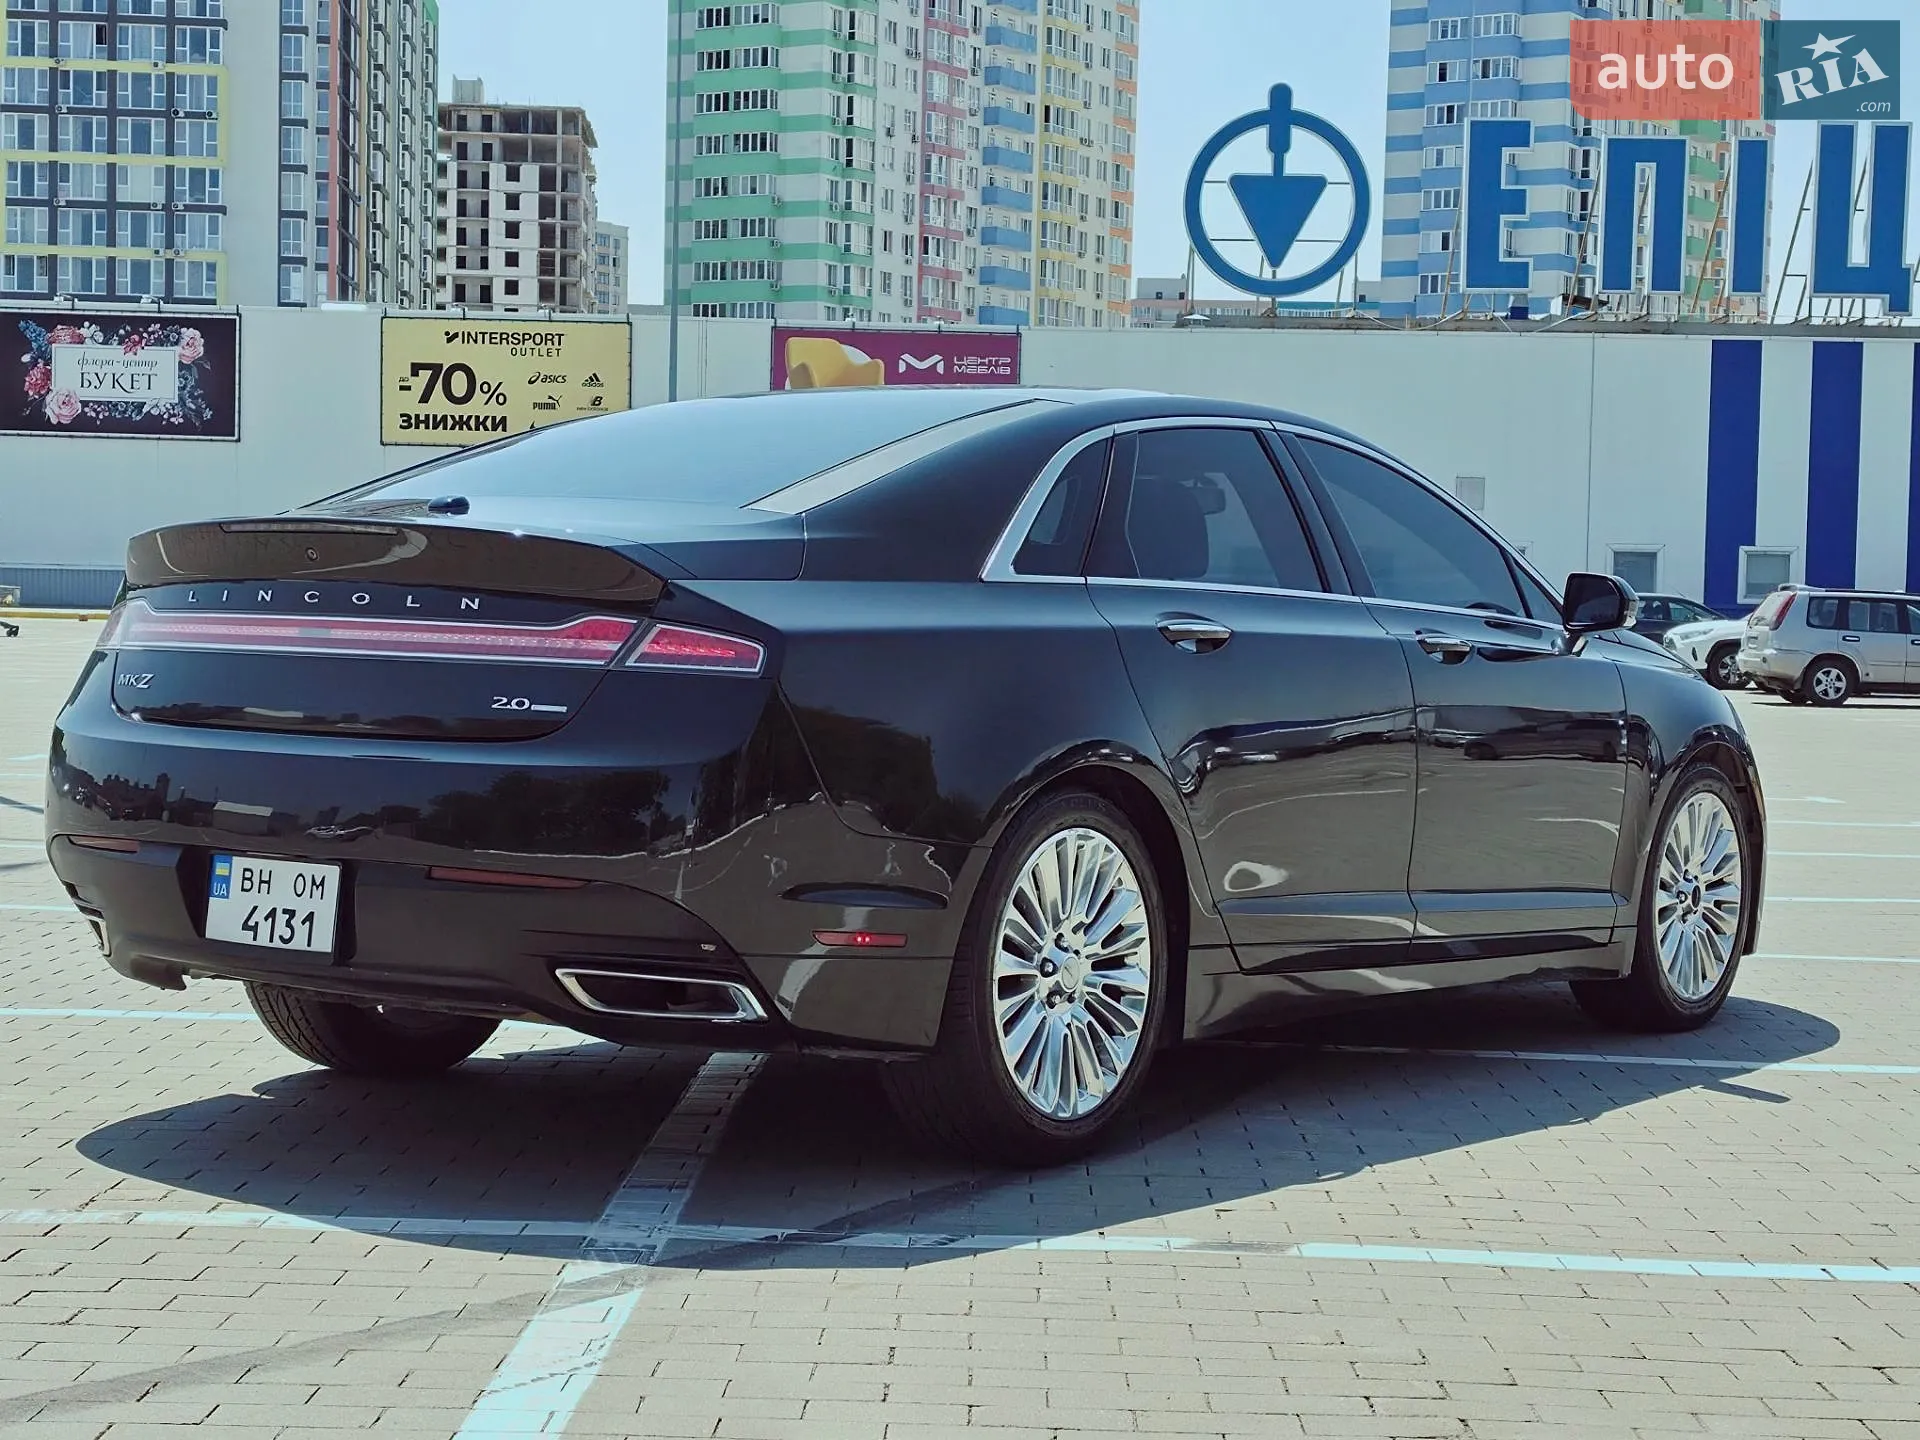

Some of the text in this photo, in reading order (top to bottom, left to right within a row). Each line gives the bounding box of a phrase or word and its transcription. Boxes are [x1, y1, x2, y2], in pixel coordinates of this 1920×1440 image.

[461, 330, 565, 347] INTERSPORT
[510, 346, 562, 358] OUTLET
[79, 371, 158, 394] БУКЕТ
[398, 413, 508, 433] ЗНИЖКИ
[187, 589, 482, 611] LINCOLN
[117, 673, 155, 689] MKZ
[212, 882, 228, 897] UA
[240, 867, 327, 901] BH OM
[240, 905, 316, 948] 4131
